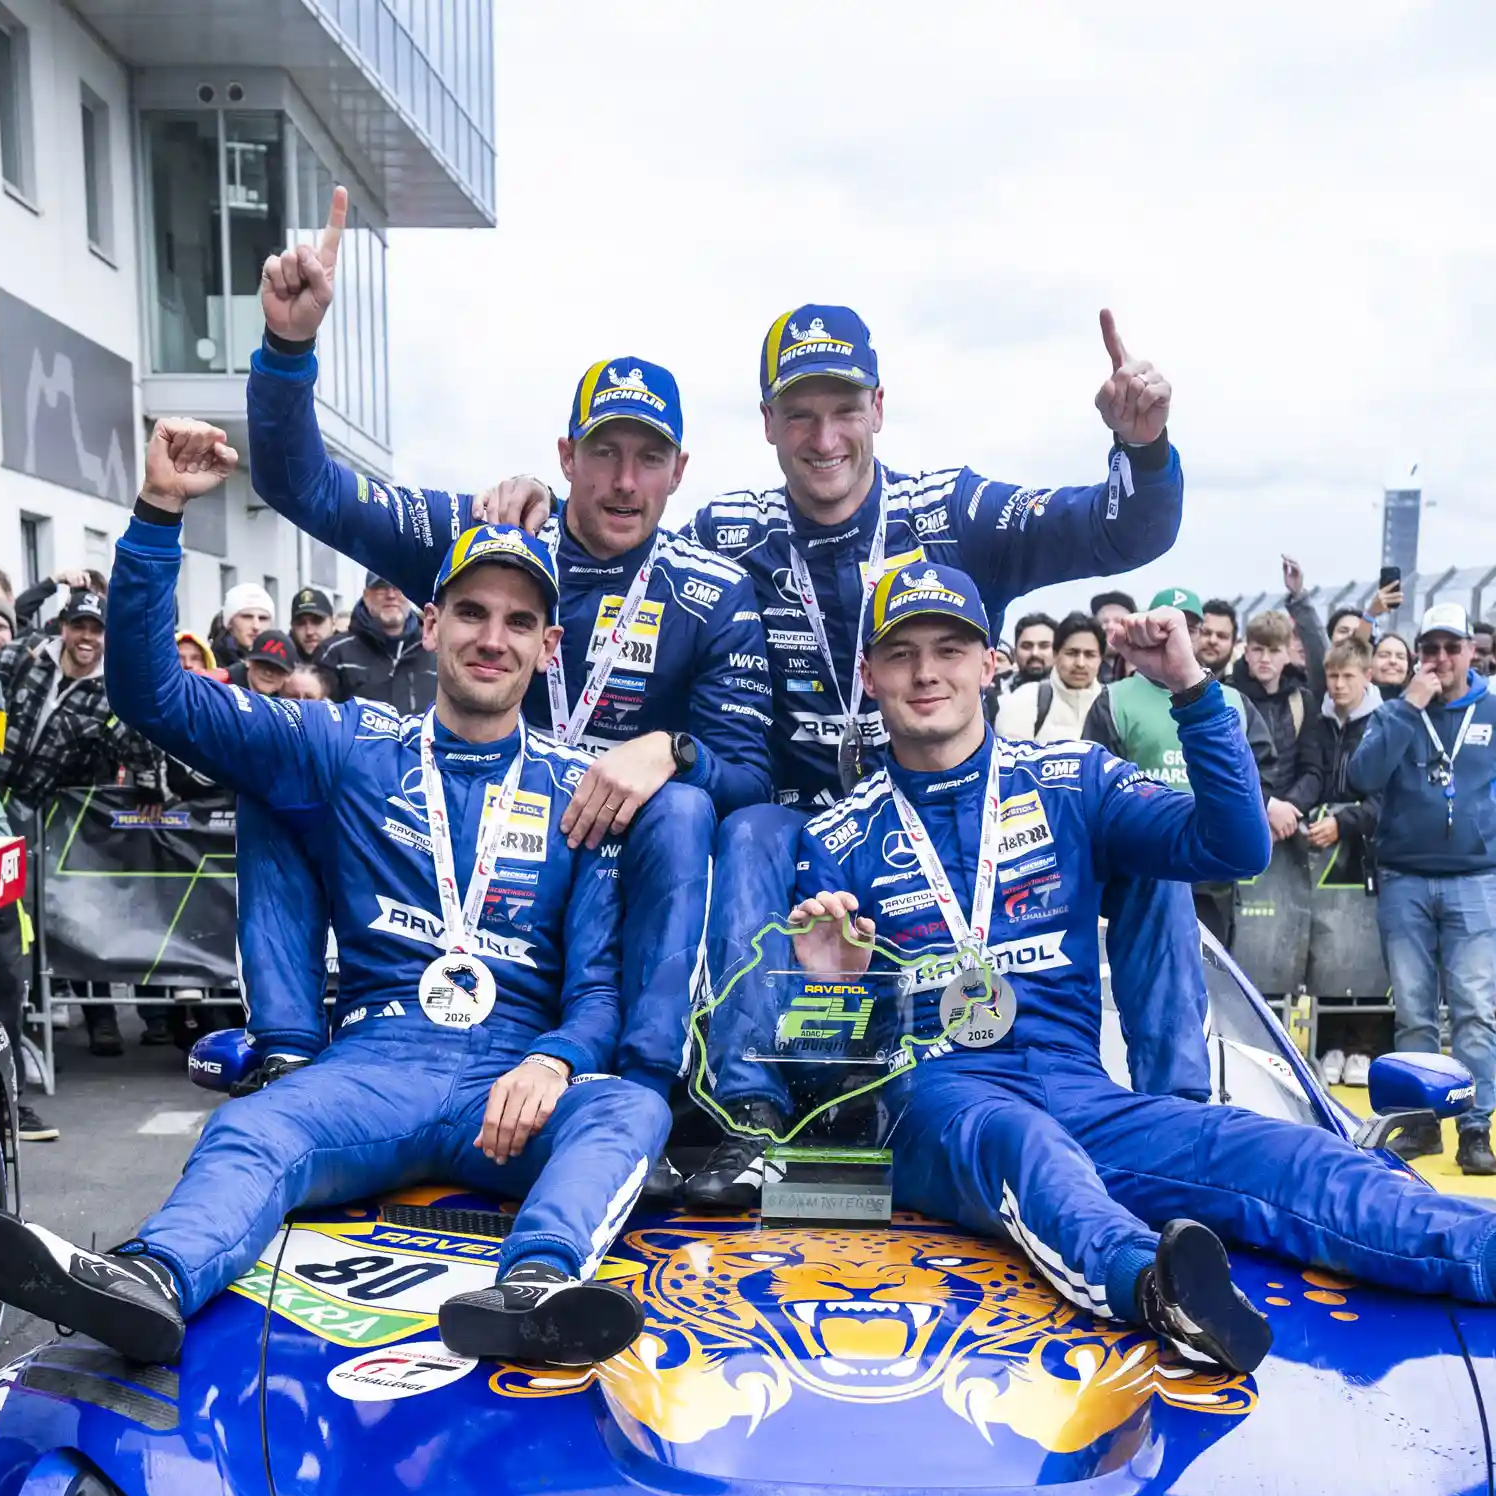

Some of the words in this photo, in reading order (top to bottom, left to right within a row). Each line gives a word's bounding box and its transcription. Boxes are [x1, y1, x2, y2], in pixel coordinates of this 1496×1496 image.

[781, 342, 853, 366] MICHELIN
[593, 388, 666, 412] MICHELIN
[916, 511, 948, 532] OMP
[717, 528, 749, 546] OMP
[682, 581, 721, 604] OMP
[888, 588, 964, 611] MICHELIN
[774, 643, 798, 651] RACING
[788, 658, 810, 669] IWC
[734, 679, 773, 697] TECHEM
[1163, 750, 1187, 766] GR
[1042, 761, 1081, 778] OMP
[1145, 768, 1189, 784] MARS
[823, 820, 858, 848] OMP
[884, 892, 935, 910] RAVENOL
[804, 984, 869, 996] RAVENOL
[444, 1012, 472, 1024] 2026
[967, 1029, 996, 1043] 2026
[371, 1230, 501, 1258] RAVE
[294, 1255, 449, 1301] 80
[353, 1374, 428, 1392] CHALLENGE
